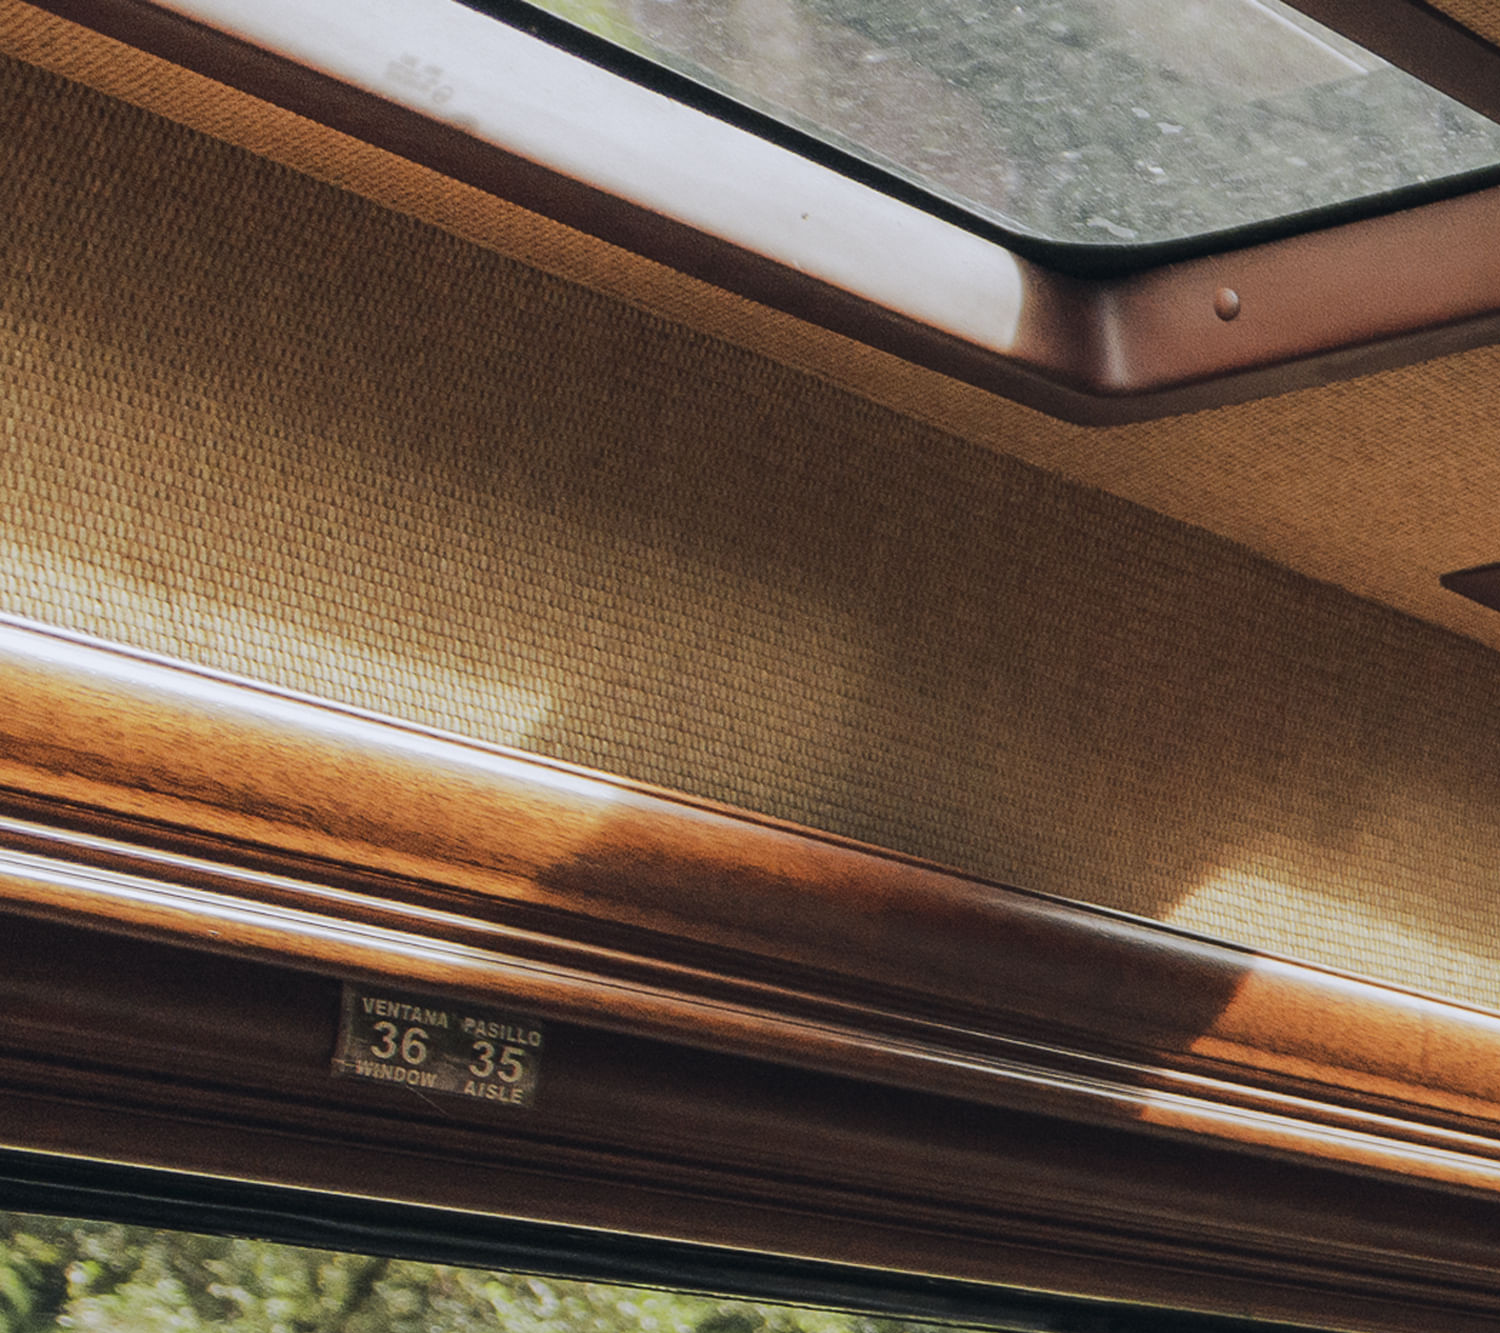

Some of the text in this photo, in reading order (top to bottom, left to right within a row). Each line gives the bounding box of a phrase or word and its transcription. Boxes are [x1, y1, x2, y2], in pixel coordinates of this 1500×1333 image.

[363, 997, 542, 1047] VENTANA PASILLO
[370, 1020, 527, 1083] 36 35
[356, 1059, 524, 1105] WINDOW AISLE
